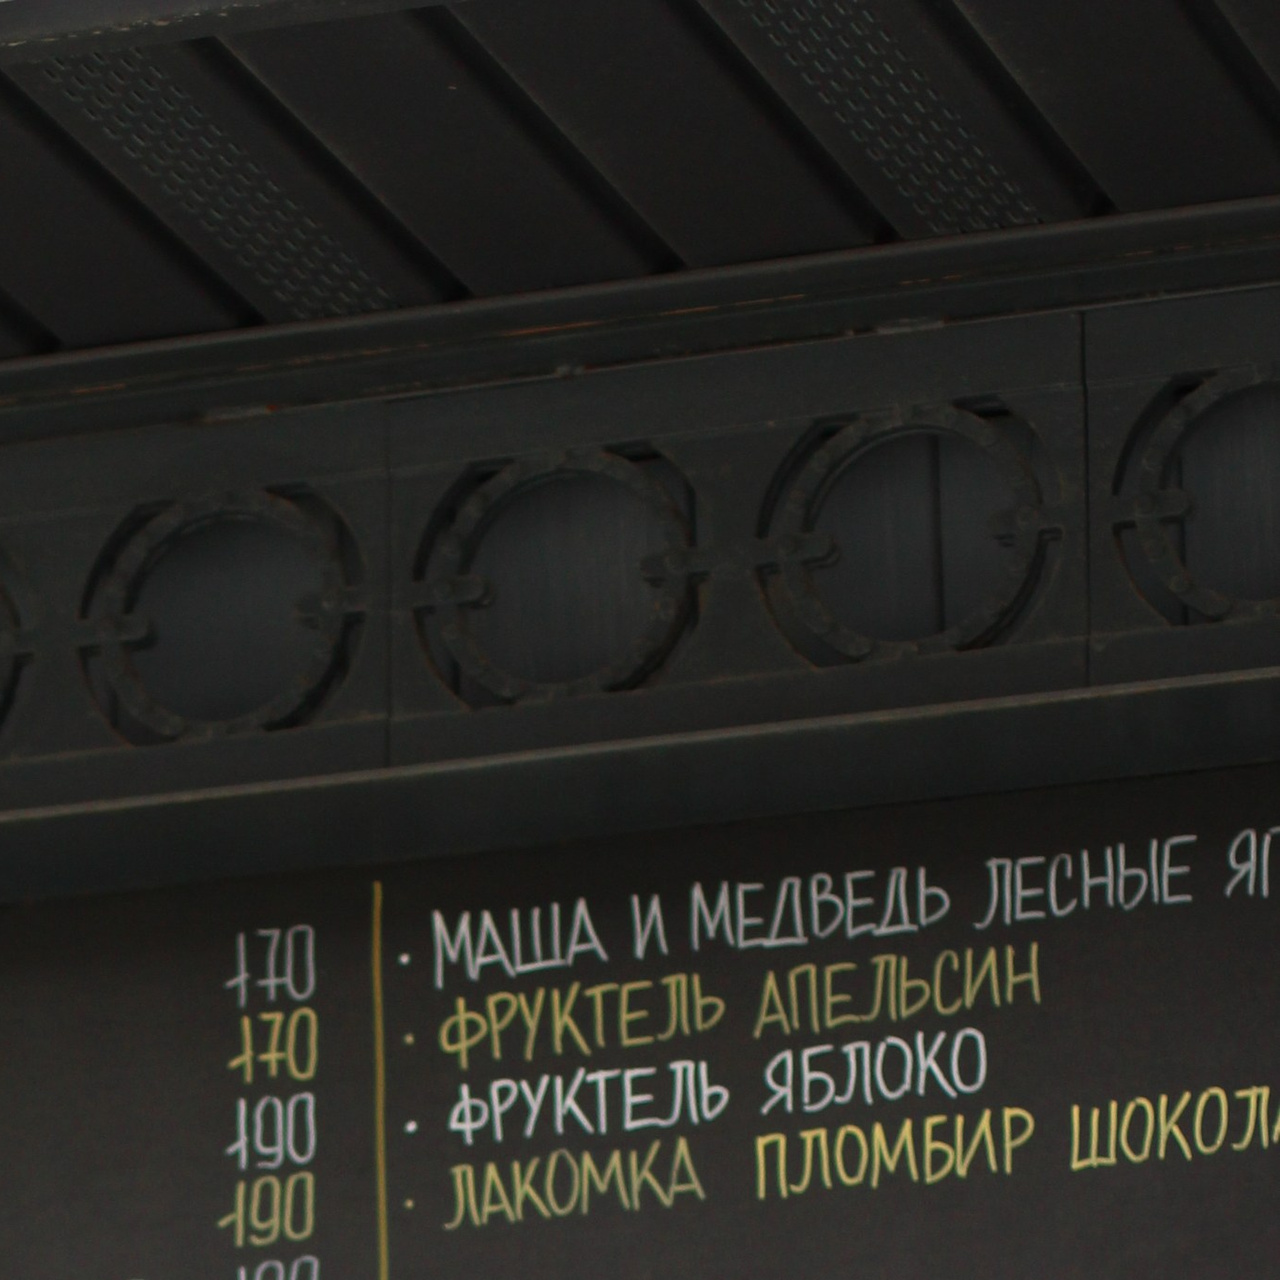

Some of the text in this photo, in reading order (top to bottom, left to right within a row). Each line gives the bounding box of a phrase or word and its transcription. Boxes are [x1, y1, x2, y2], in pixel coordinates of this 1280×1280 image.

[432, 897, 608, 989] МАША
[631, 894, 668, 959] И
[690, 866, 950, 951] МЕДВЕДЬ
[974, 835, 1197, 929] ЛЕСНЫЕ
[225, 924, 315, 1007] 170
[439, 942, 1041, 1070] ФРУКТЕЛЬ АПЕЛЬСИН
[228, 1007, 318, 1083] 170
[448, 1027, 987, 1146] ФРУКТЕЛЬ ЯБЛОКО
[225, 1092, 316, 1170] 190
[444, 1084, 1280, 1230] ЛАКОМКА ПЛОМБИР ШОКОЛ
[217, 1171, 314, 1247] 190
